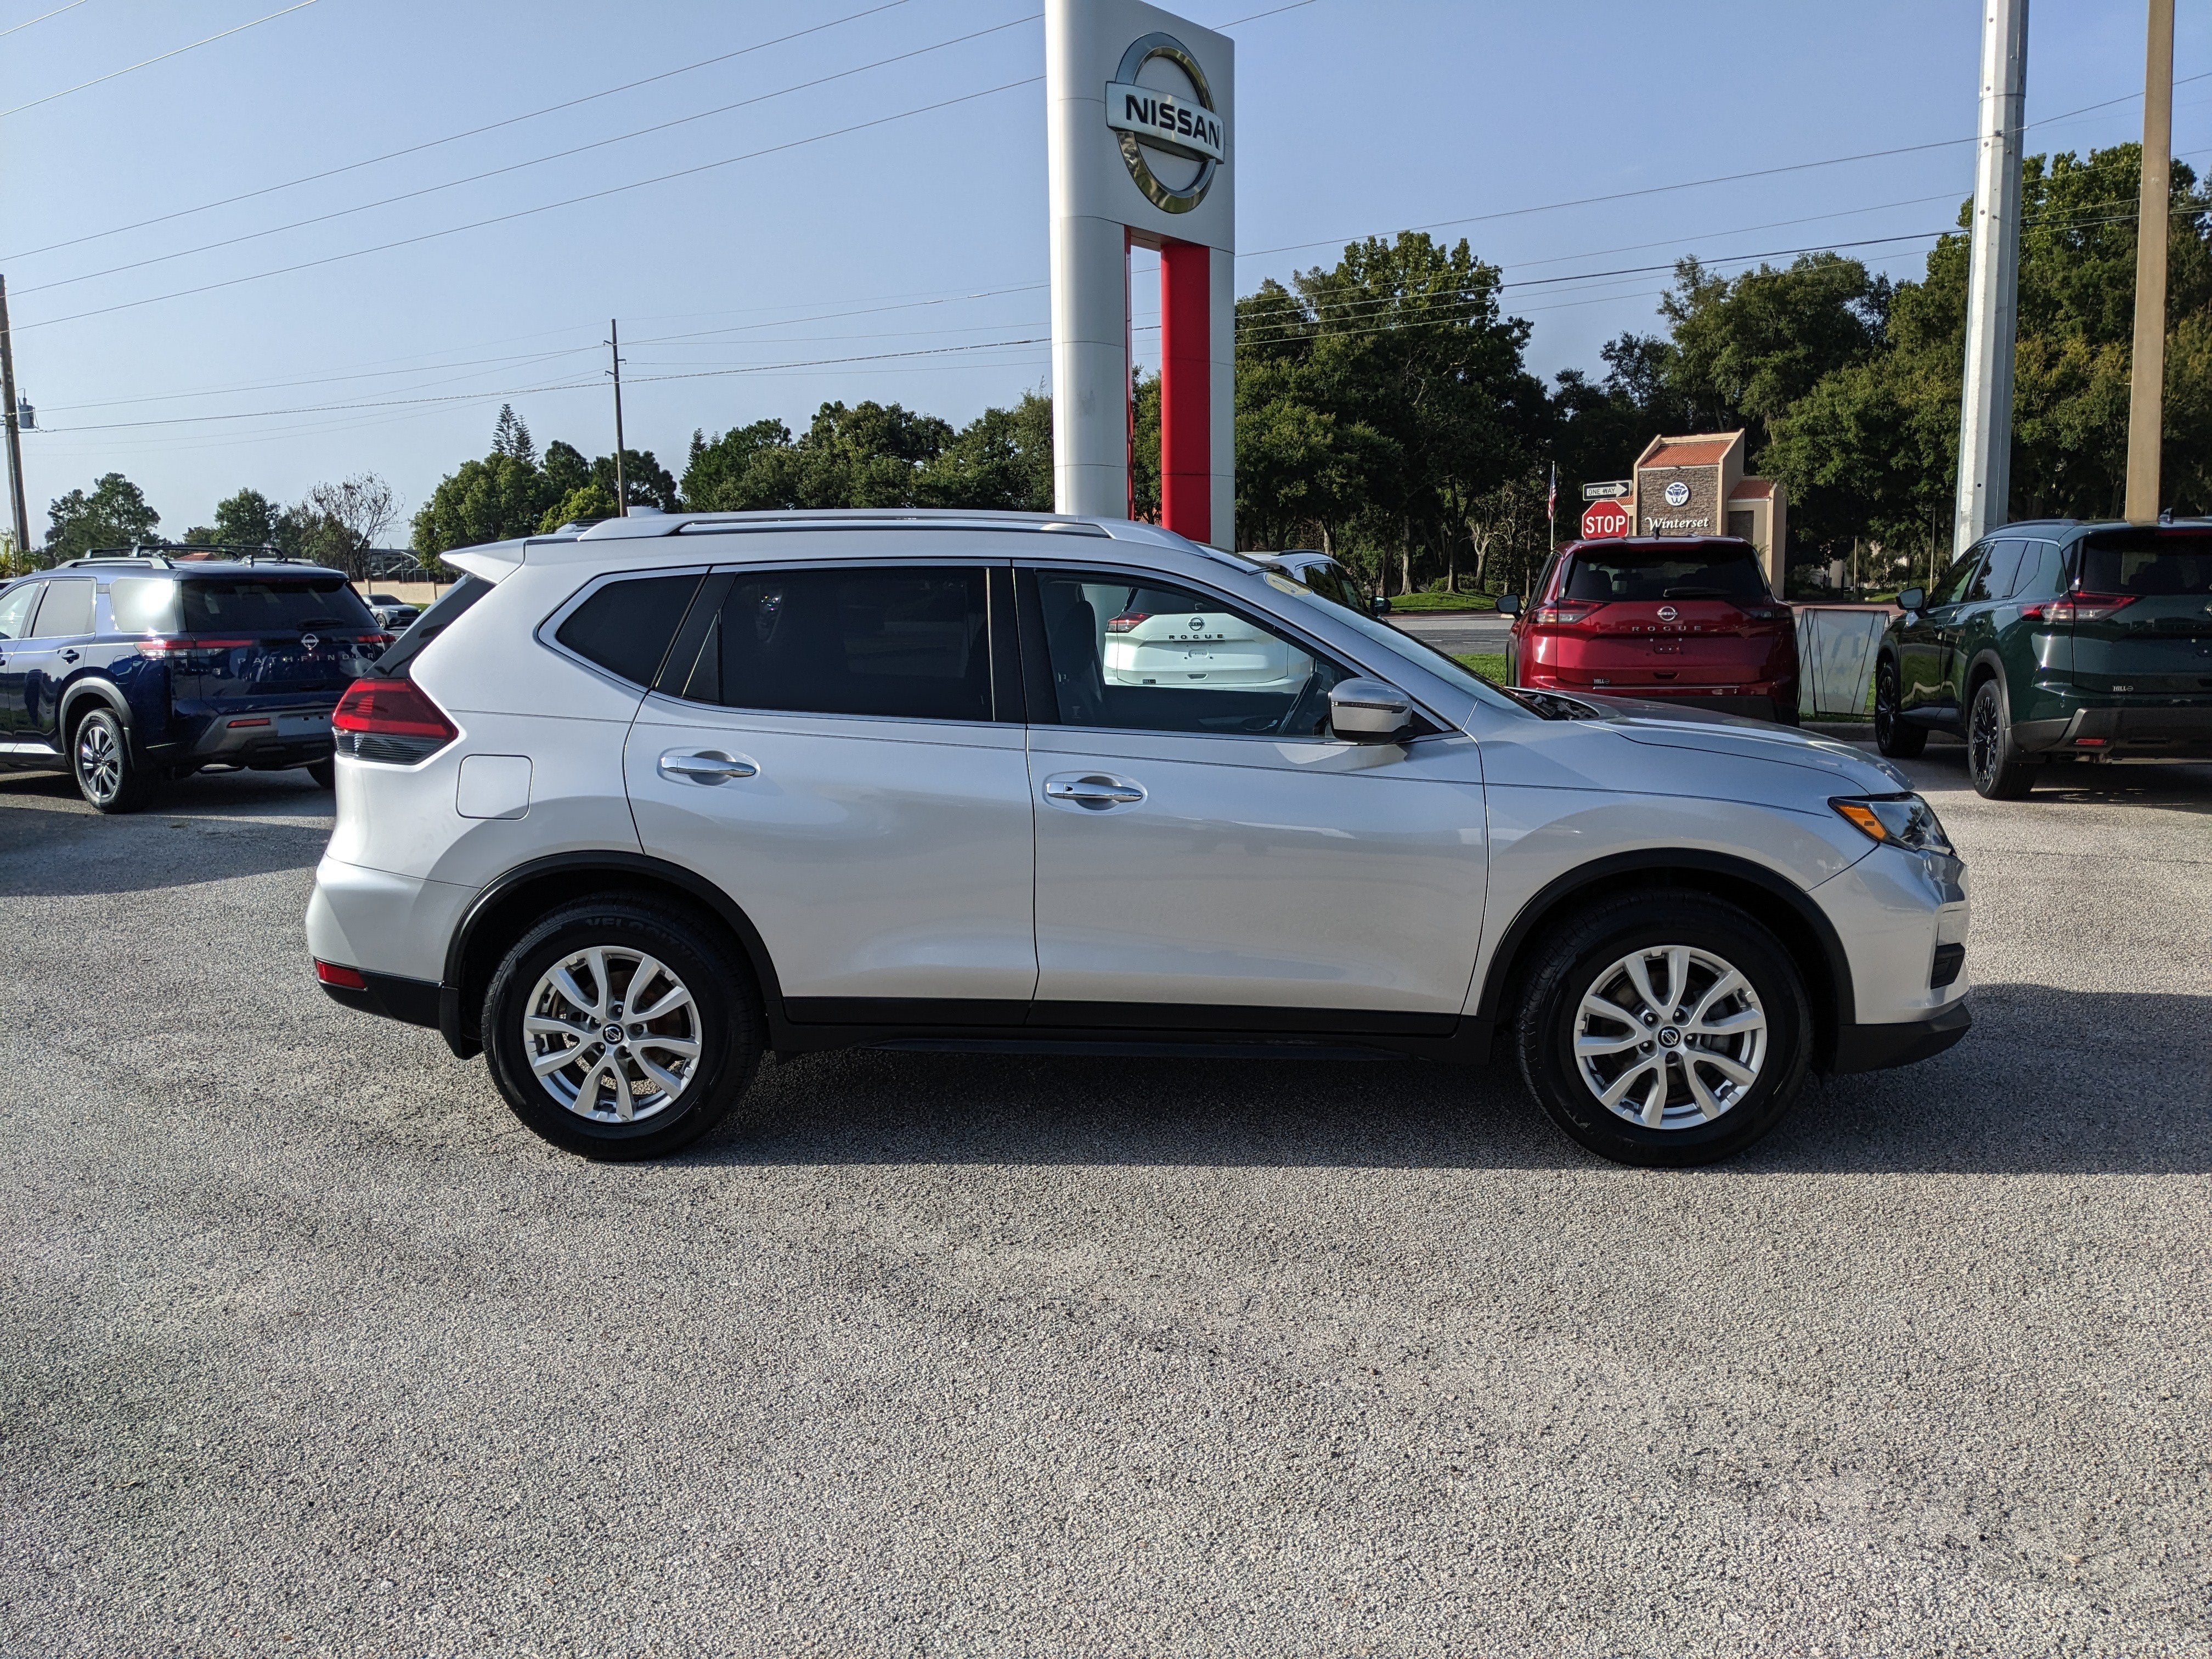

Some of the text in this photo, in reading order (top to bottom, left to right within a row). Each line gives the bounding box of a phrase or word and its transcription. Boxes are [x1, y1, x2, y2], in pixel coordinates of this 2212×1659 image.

[1125, 94, 1221, 150] NISSAN
[1585, 516, 1626, 534] STOP
[1645, 517, 1709, 531] Winterset
